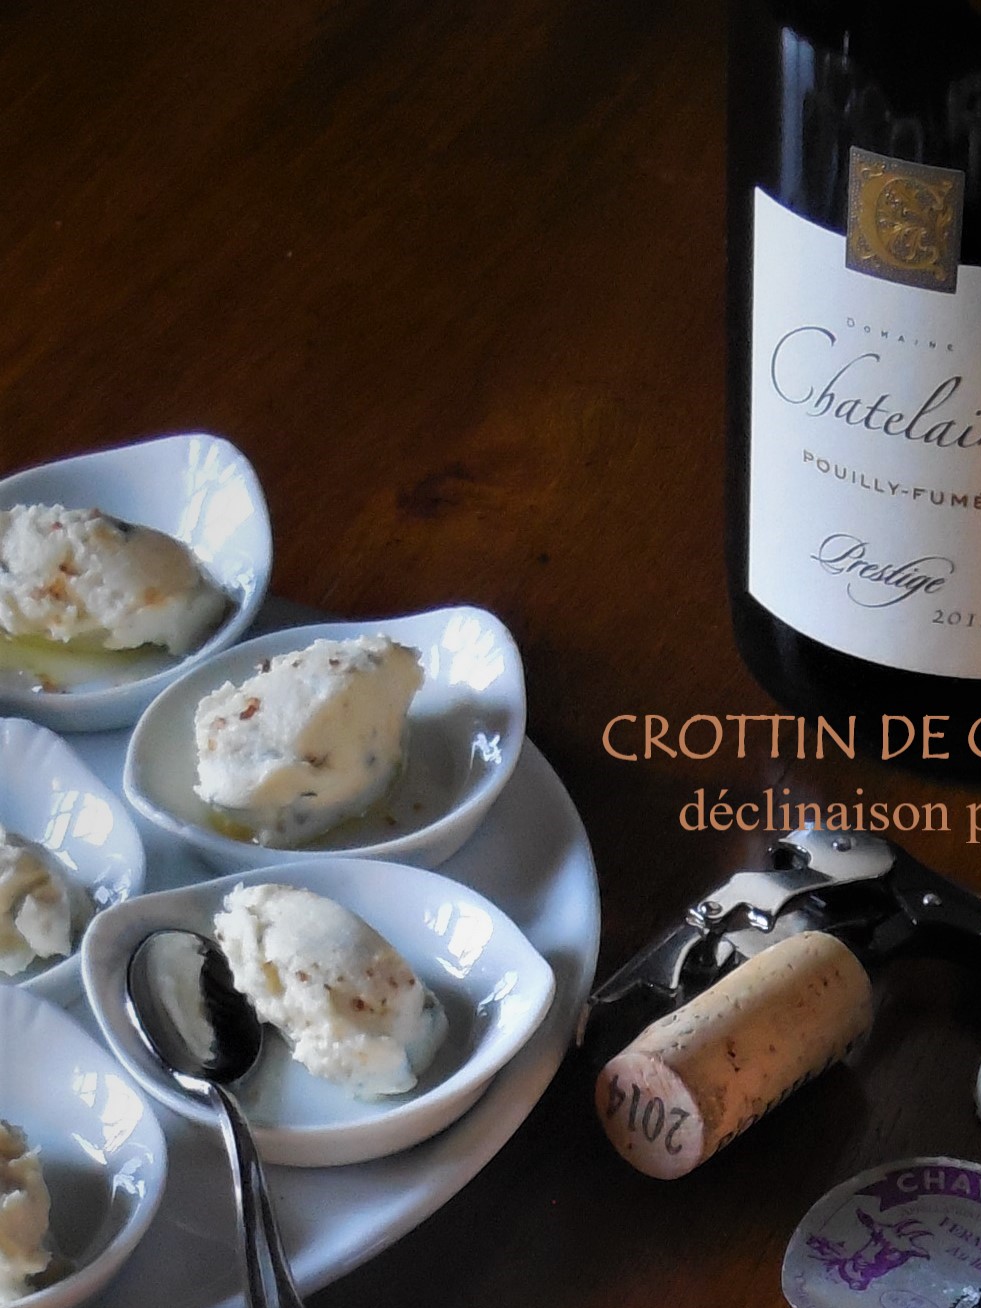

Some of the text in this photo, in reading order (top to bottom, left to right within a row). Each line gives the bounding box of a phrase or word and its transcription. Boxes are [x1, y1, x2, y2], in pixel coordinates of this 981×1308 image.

[847, 317, 955, 352] DOMAINE
[810, 532, 955, 608] Prestige
[606, 1074, 690, 1156] 2014
